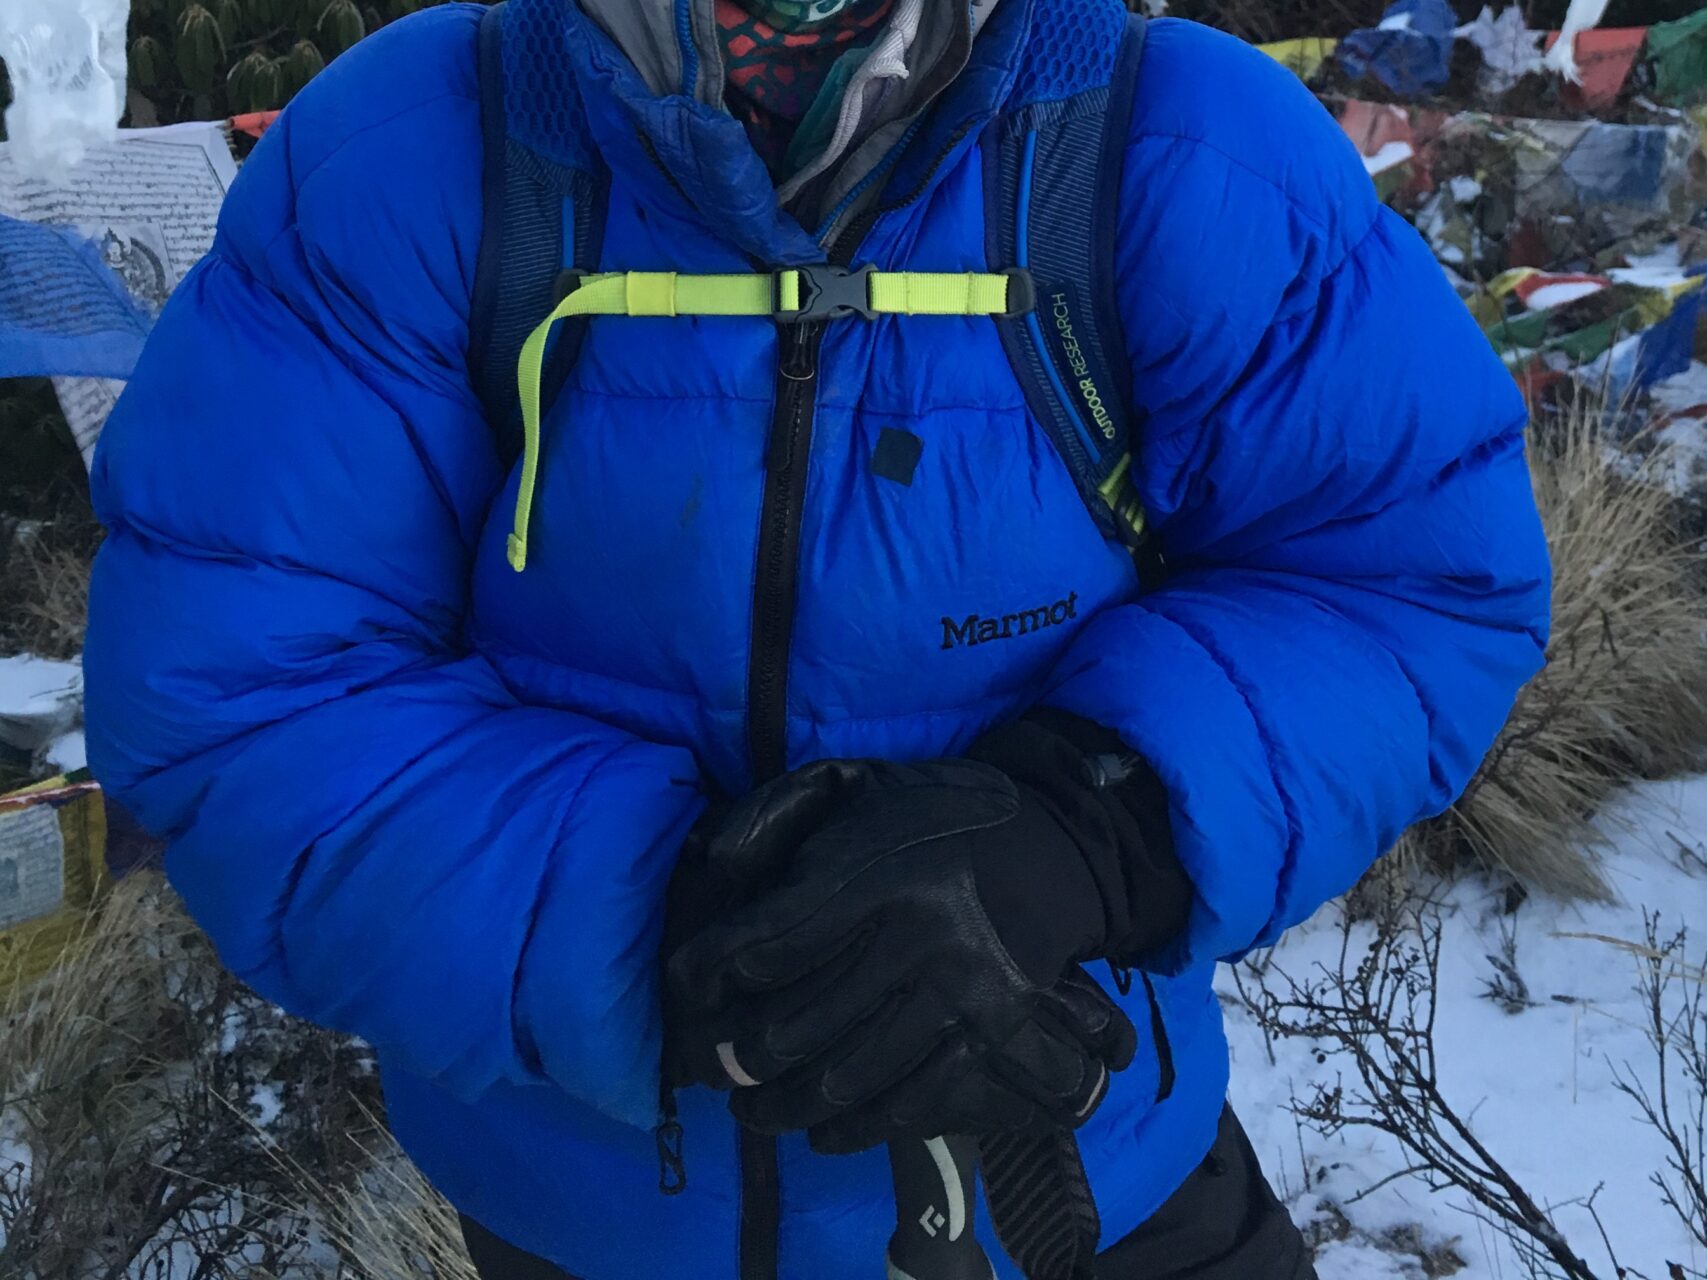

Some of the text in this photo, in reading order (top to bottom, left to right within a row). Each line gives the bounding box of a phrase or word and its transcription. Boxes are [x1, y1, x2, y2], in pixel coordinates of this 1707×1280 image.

[1051, 293, 1116, 439] OUTDOOR RESEARCH
[941, 591, 1078, 650] Marmot
